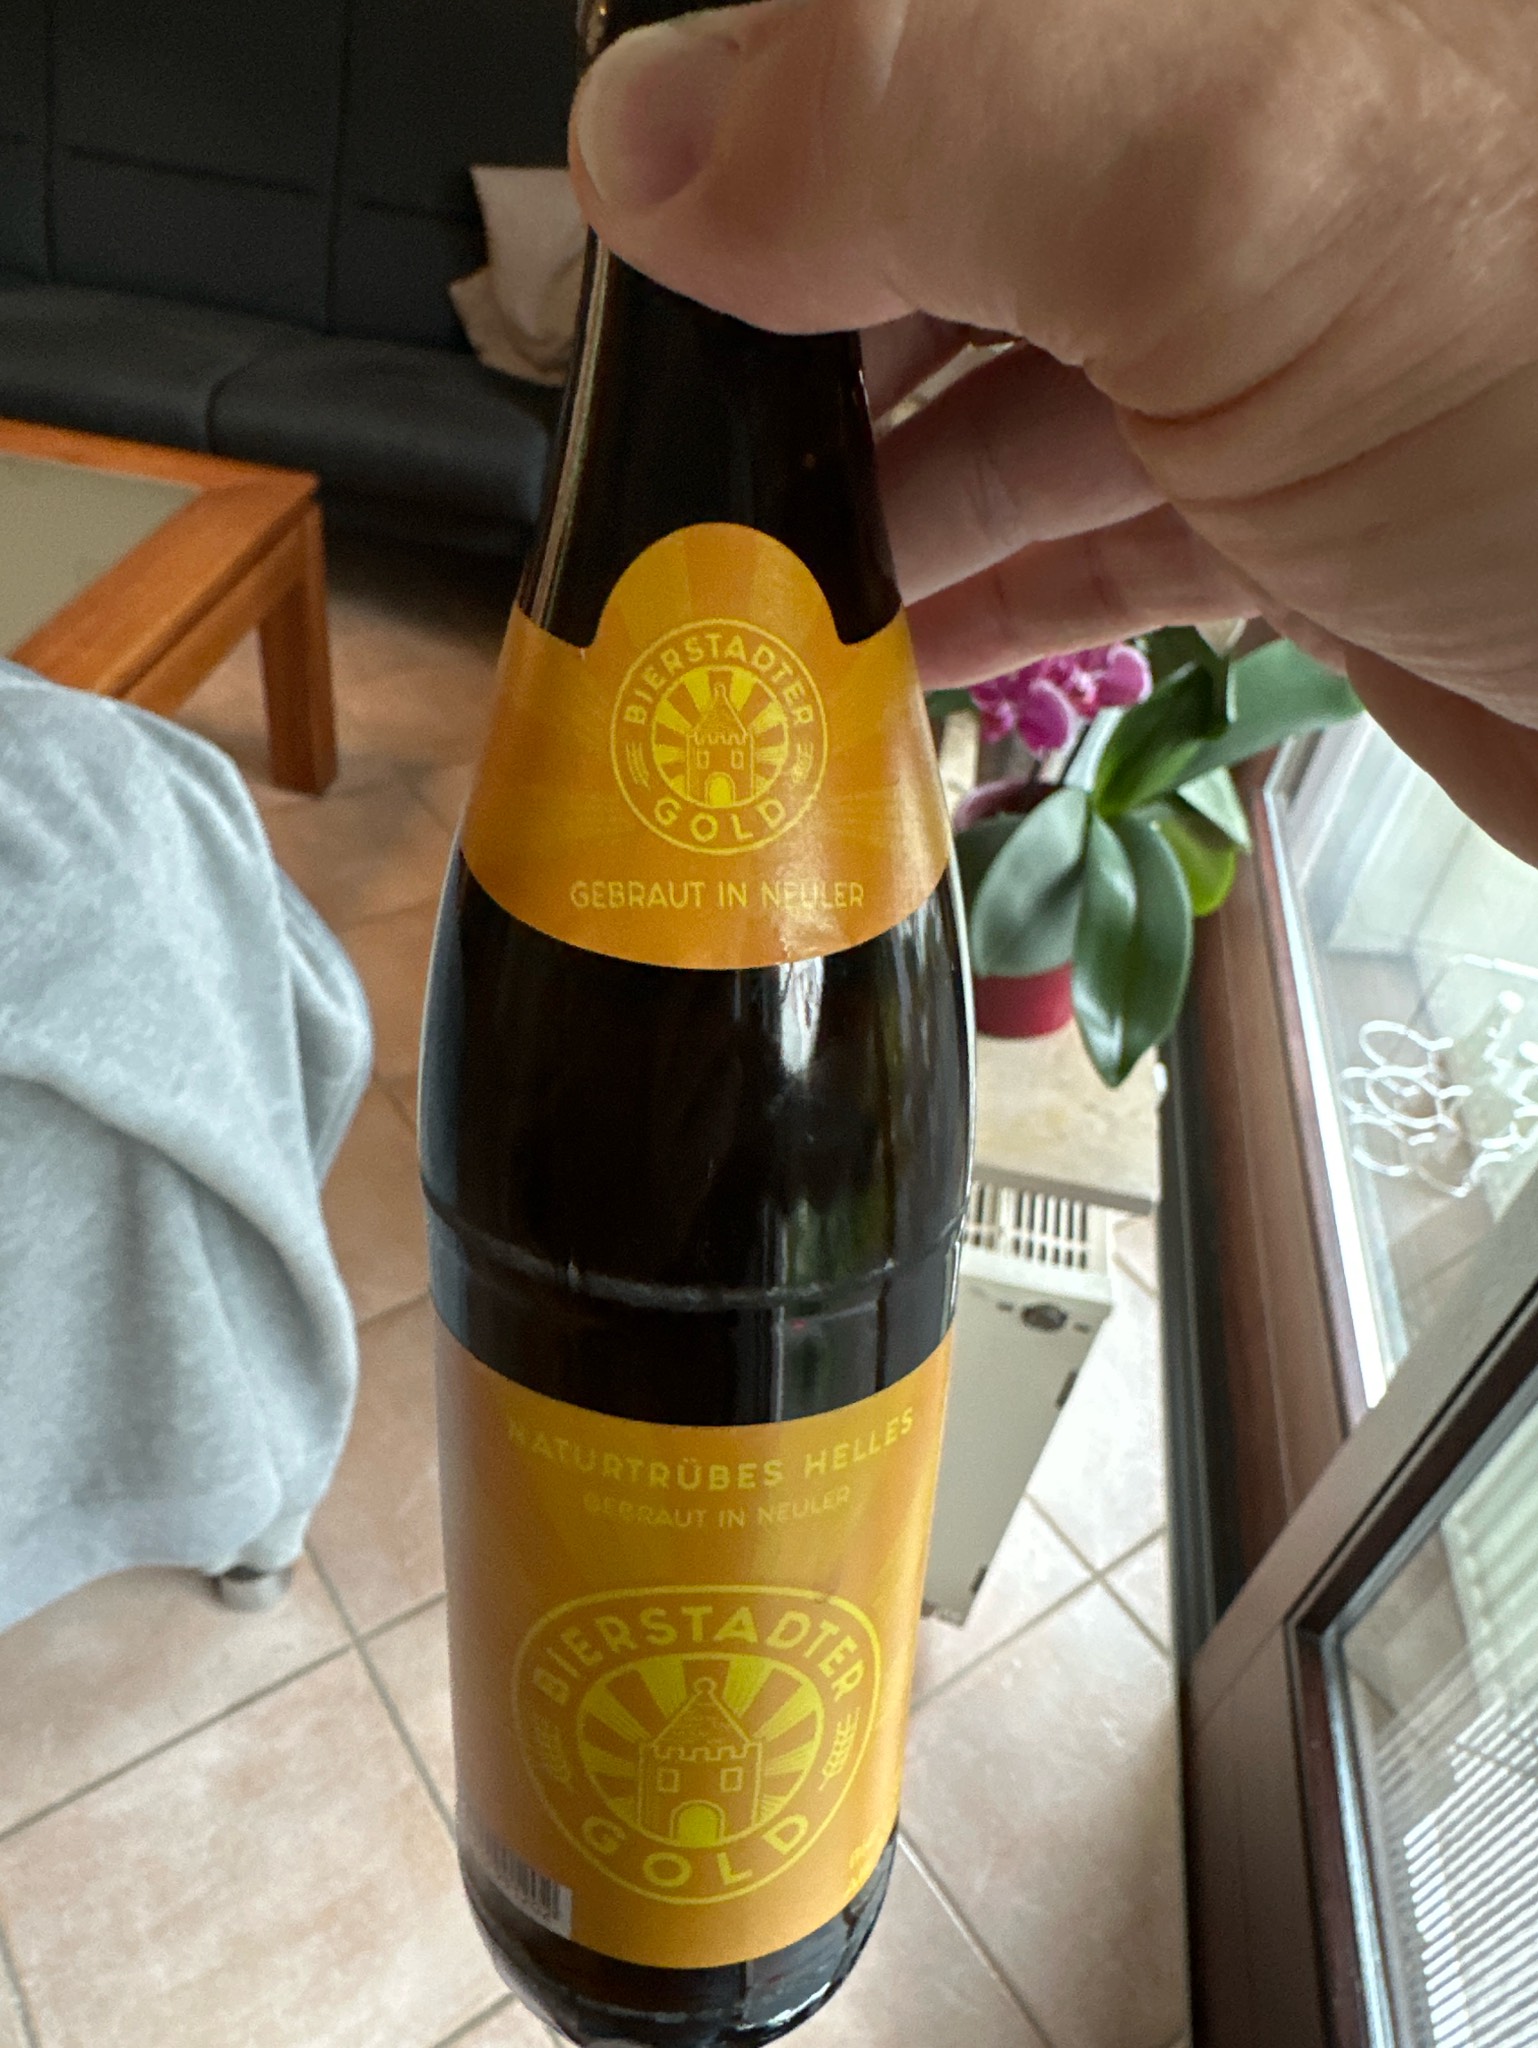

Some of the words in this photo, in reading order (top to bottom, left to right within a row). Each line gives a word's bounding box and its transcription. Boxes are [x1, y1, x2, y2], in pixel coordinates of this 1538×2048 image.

[625, 633, 814, 725] BIERSTADTER
[654, 798, 786, 841] GOLD
[569, 881, 705, 908] GEBRAUT
[718, 881, 747, 908] IN
[762, 881, 864, 908] NEULER
[508, 1420, 784, 1491] NATURTRÜBES
[804, 1407, 914, 1478] HELLES
[583, 1493, 706, 1528] GEBRAUT
[718, 1509, 745, 1528] IN
[757, 1485, 851, 1523] NEULER
[533, 1606, 864, 1704] BIERSTADTER
[581, 1815, 809, 1888] GOLD
